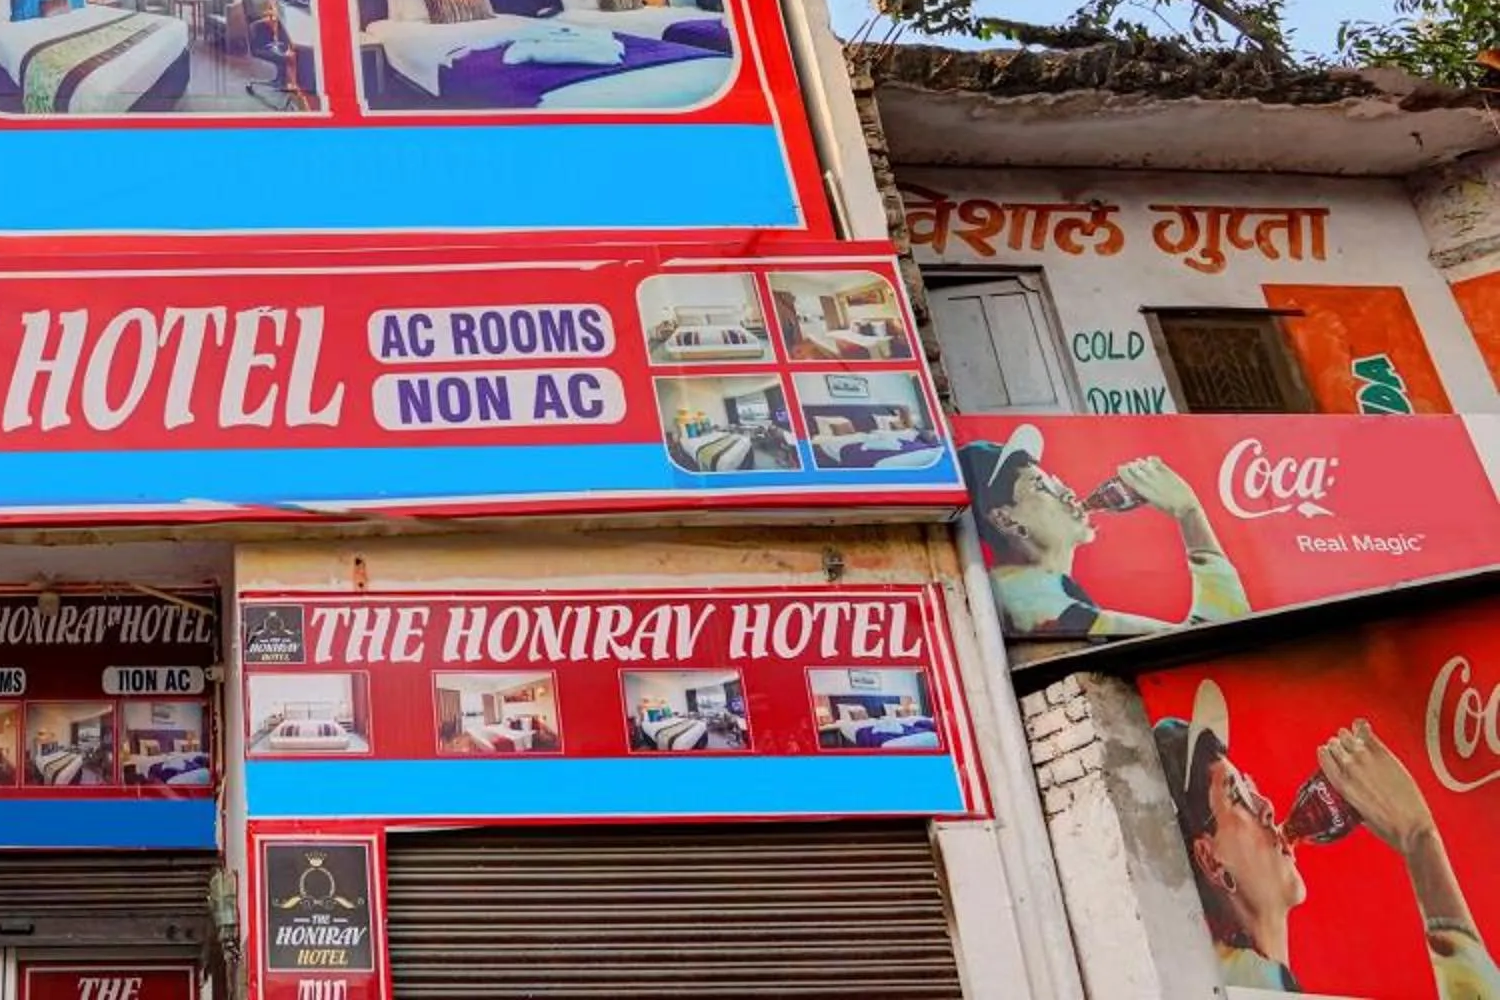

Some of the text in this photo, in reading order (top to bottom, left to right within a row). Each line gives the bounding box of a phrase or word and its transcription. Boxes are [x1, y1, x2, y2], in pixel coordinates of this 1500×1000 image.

[1149, 203, 1331, 275] गुप्ता
[379, 307, 607, 358] AC ROOMS
[1072, 330, 1146, 362] COLD
[1, 305, 345, 432] HOTEL
[396, 372, 606, 425] NON AC
[1086, 386, 1167, 415] DRINK
[1296, 534, 1349, 554] Real
[116, 604, 212, 646] HOTEL
[309, 600, 924, 664] THE HONIRAV HOTEL
[164, 668, 192, 692] AC
[311, 913, 331, 925] THE
[275, 925, 368, 946] HONIRAV
[297, 948, 349, 966] HOTEL
[76, 976, 143, 1000] THE
